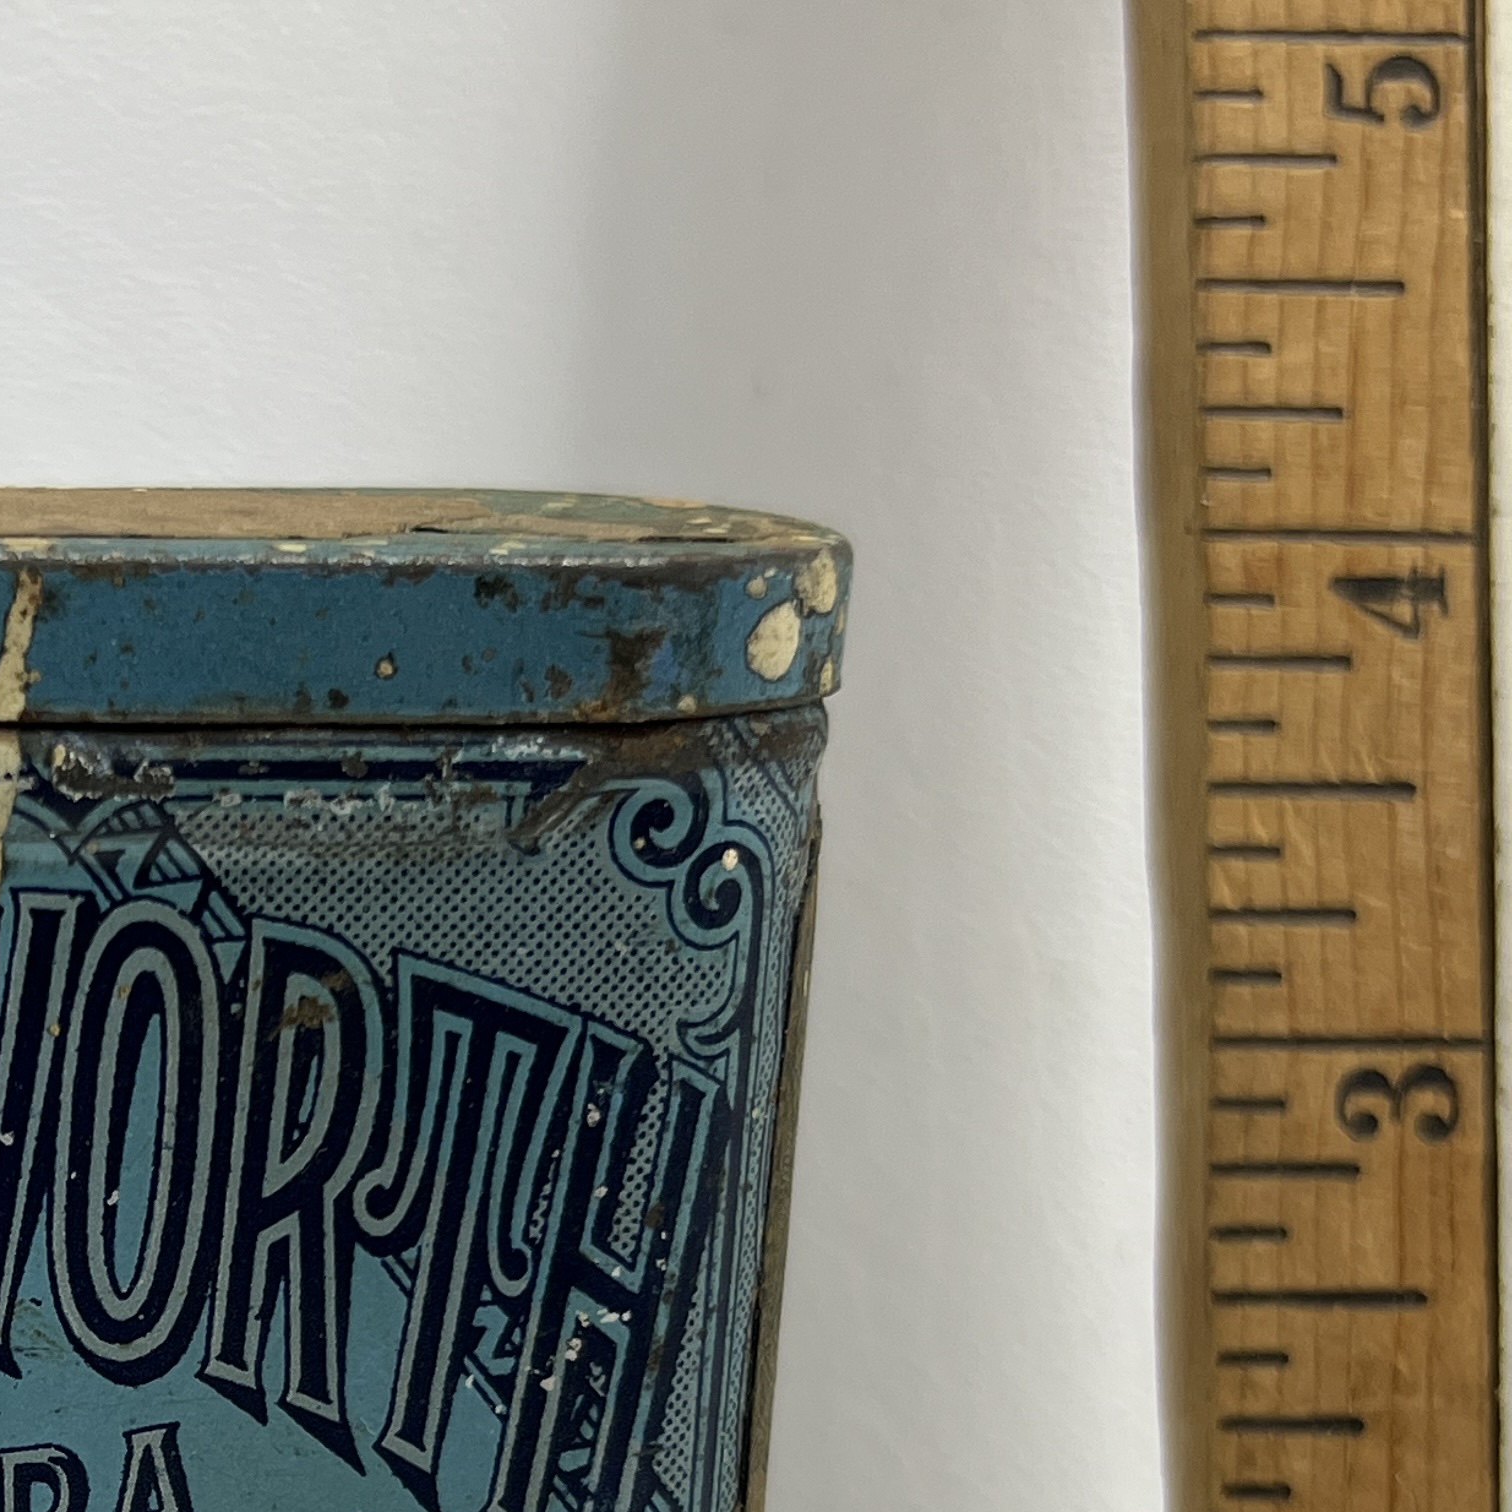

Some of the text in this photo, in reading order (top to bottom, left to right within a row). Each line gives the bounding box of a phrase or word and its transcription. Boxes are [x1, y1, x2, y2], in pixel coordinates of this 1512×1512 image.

[1324, 55, 1441, 130] 5
[1330, 564, 1449, 640] 4
[1334, 1064, 1461, 1142] 3
